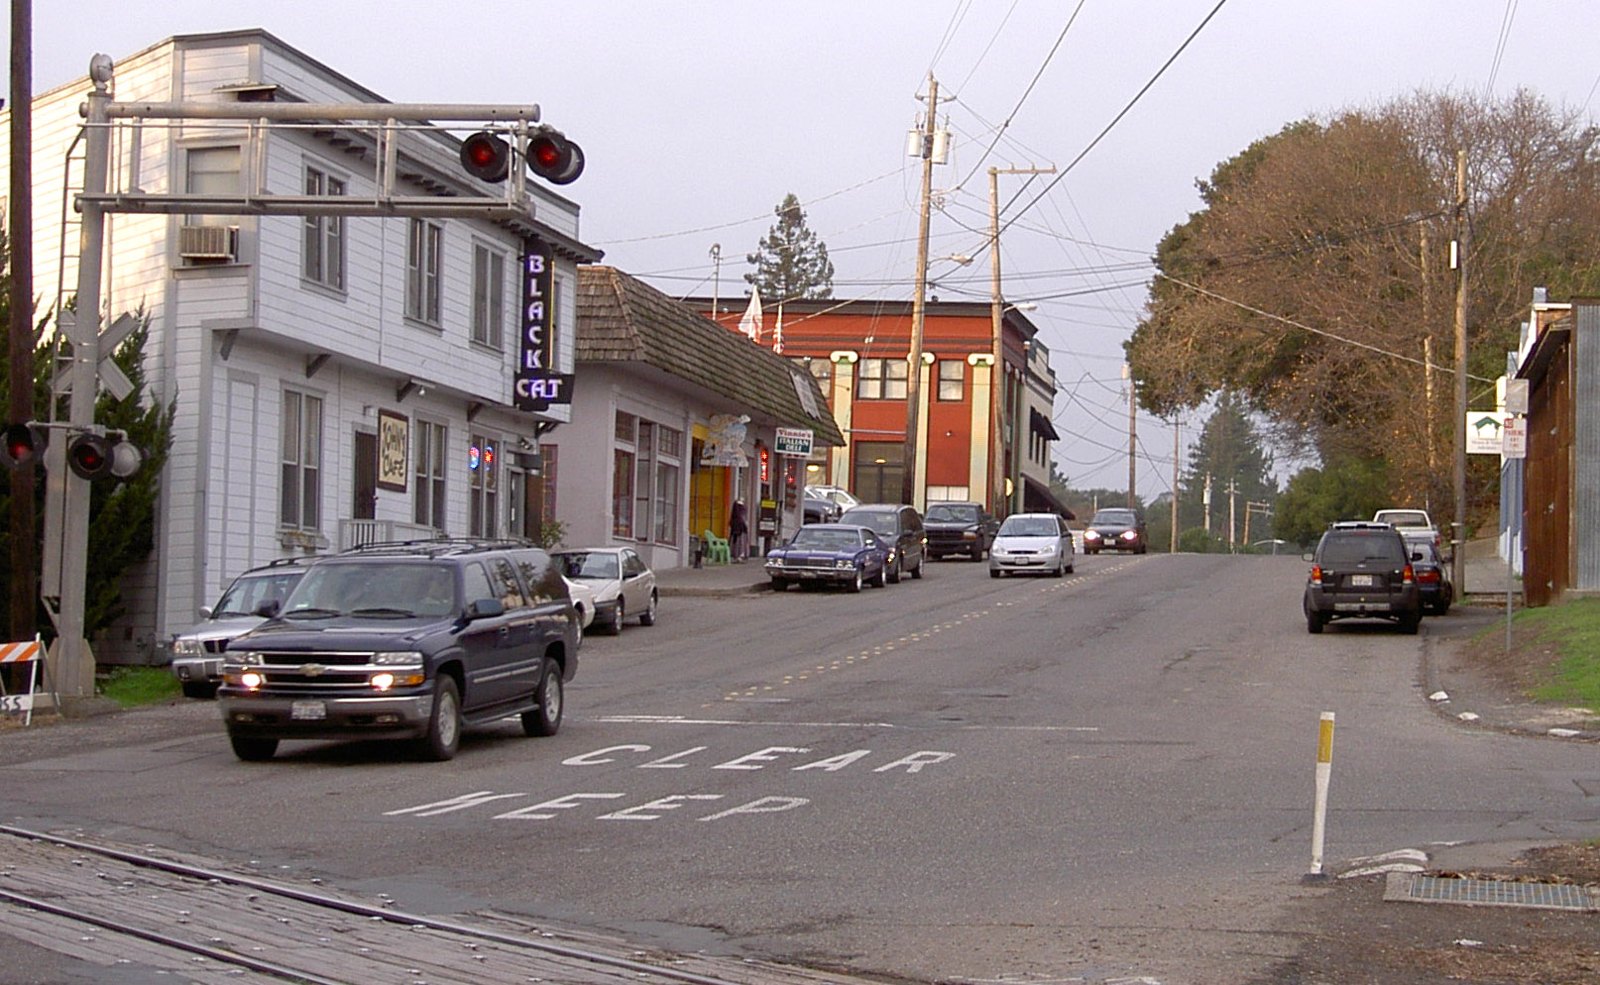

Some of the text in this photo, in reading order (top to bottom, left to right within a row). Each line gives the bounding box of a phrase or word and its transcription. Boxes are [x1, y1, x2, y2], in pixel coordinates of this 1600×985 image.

[526, 254, 546, 369] BLACK
[516, 378, 563, 399] CAT
[779, 437, 809, 446] ITALIAN
[562, 743, 957, 774] CLEAR
[382, 790, 811, 822] KEEP
